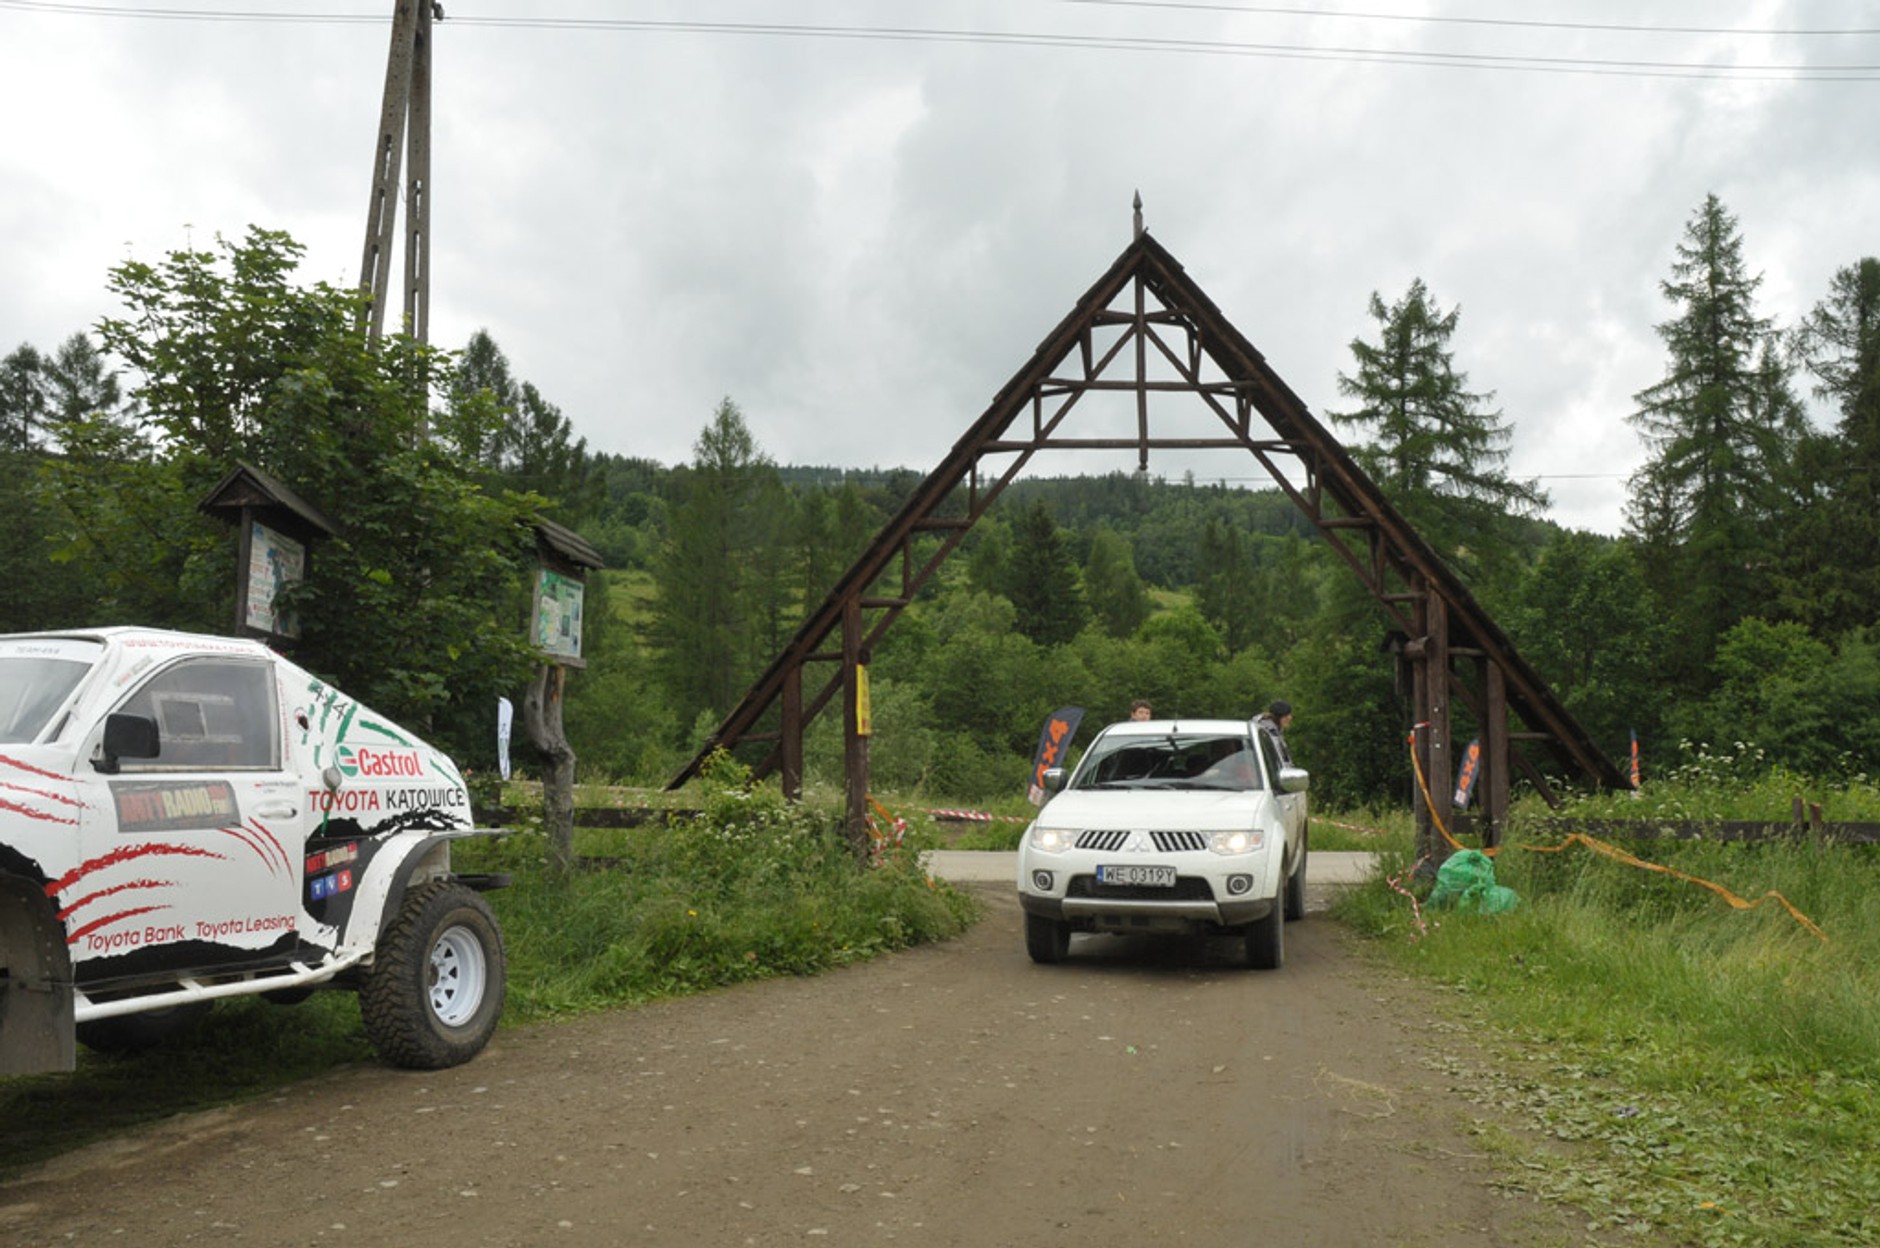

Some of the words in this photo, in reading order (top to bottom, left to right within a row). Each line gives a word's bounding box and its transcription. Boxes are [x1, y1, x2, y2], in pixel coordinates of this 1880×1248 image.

[358, 748, 424, 776] Castrol
[308, 788, 380, 812] TOYOTA
[386, 788, 466, 809] KATOWICE
[313, 873, 350, 897] TVS
[1105, 867, 1125, 881] WE
[1129, 867, 1173, 883] 0319Y
[87, 930, 140, 953] Toyota
[144, 924, 185, 943] Bank
[196, 919, 243, 938] Toyota
[246, 915, 295, 932] Leasing
